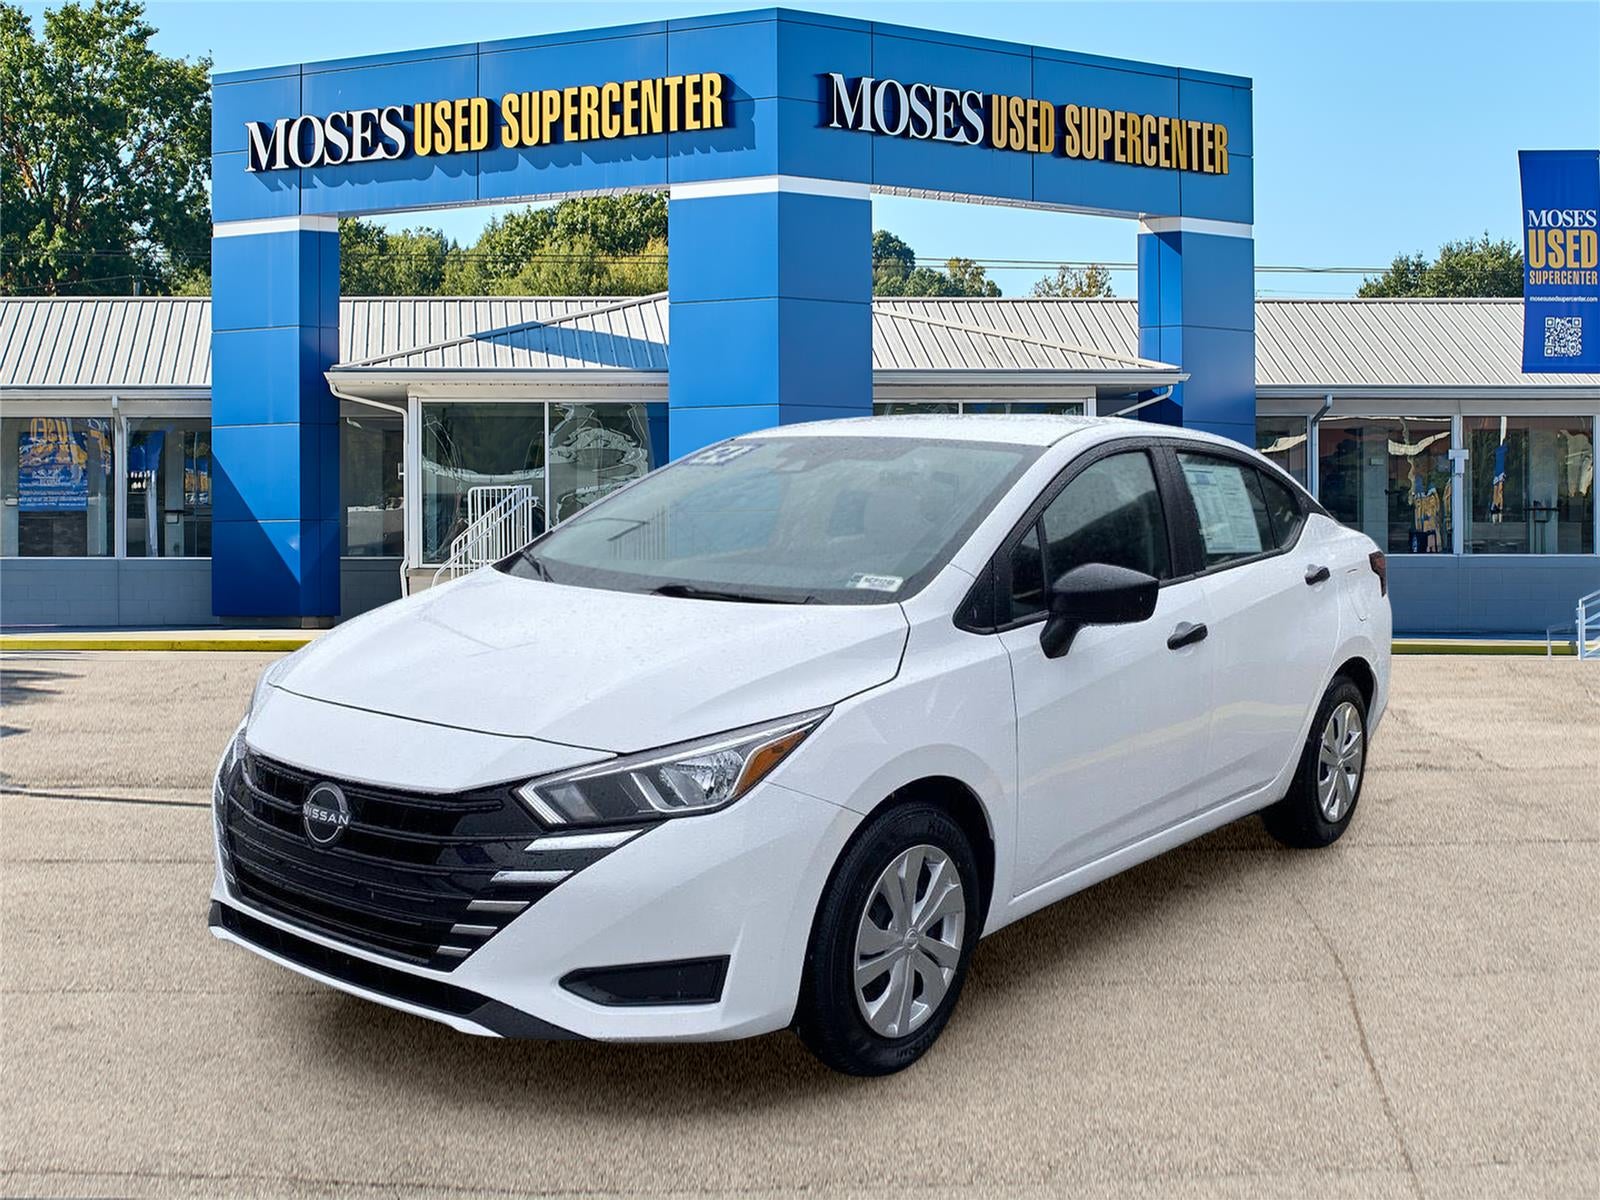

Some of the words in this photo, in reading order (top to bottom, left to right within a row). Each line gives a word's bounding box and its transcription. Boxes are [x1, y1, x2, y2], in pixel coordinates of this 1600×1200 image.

[245, 105, 406, 173] MOSES
[413, 96, 489, 157] USED
[501, 72, 724, 149] SUPERCENTER
[828, 72, 985, 146] MOSES
[991, 94, 1056, 154] USED
[1065, 103, 1230, 175] SUPERCENTER
[1528, 209, 1597, 227] MOSES
[1528, 229, 1598, 268] USED
[1529, 270, 1597, 285] SUPERCENTER
[303, 802, 350, 825] NISSAN
